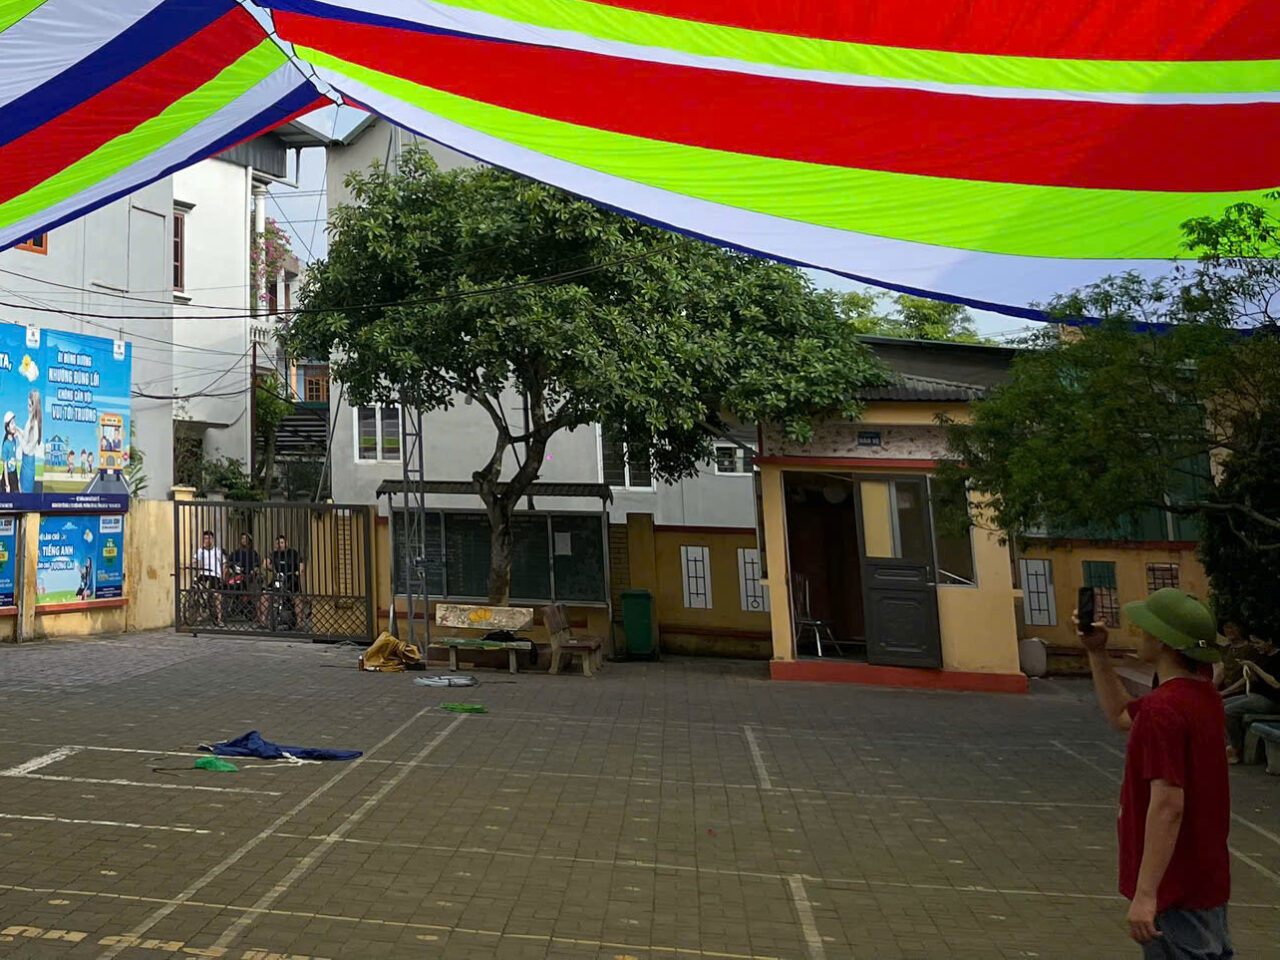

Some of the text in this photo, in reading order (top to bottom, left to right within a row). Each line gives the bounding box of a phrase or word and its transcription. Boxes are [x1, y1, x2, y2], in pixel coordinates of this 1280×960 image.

[0, 353, 12, 371] TA,
[42, 543, 74, 557] TIẾNG ANH
